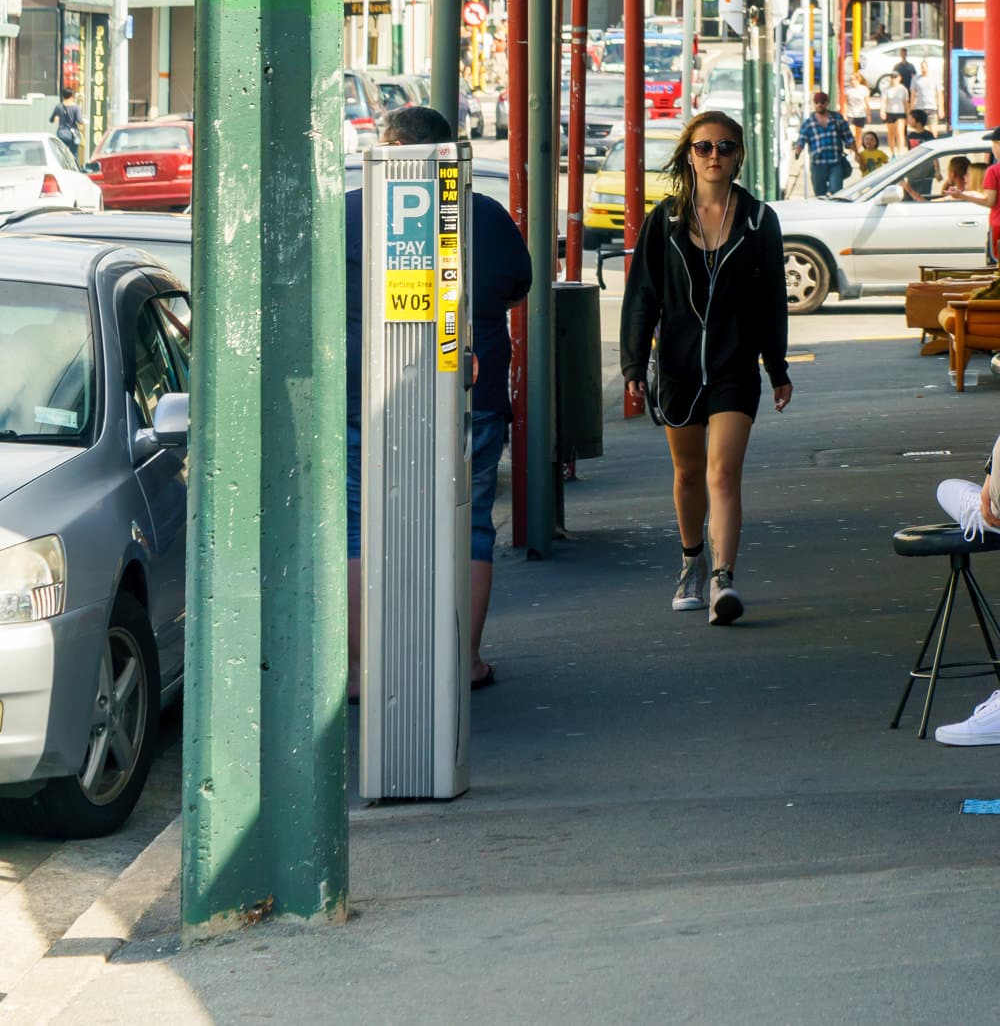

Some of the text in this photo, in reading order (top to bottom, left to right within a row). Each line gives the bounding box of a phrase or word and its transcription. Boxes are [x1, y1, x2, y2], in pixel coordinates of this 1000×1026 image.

[93, 25, 105, 146] PALOMINO
[439, 167, 458, 179] HOW
[445, 179, 457, 190] TO
[442, 190, 458, 202] PAY
[392, 185, 431, 236] P
[396, 240, 426, 255] PAY
[388, 256, 433, 270] HERE
